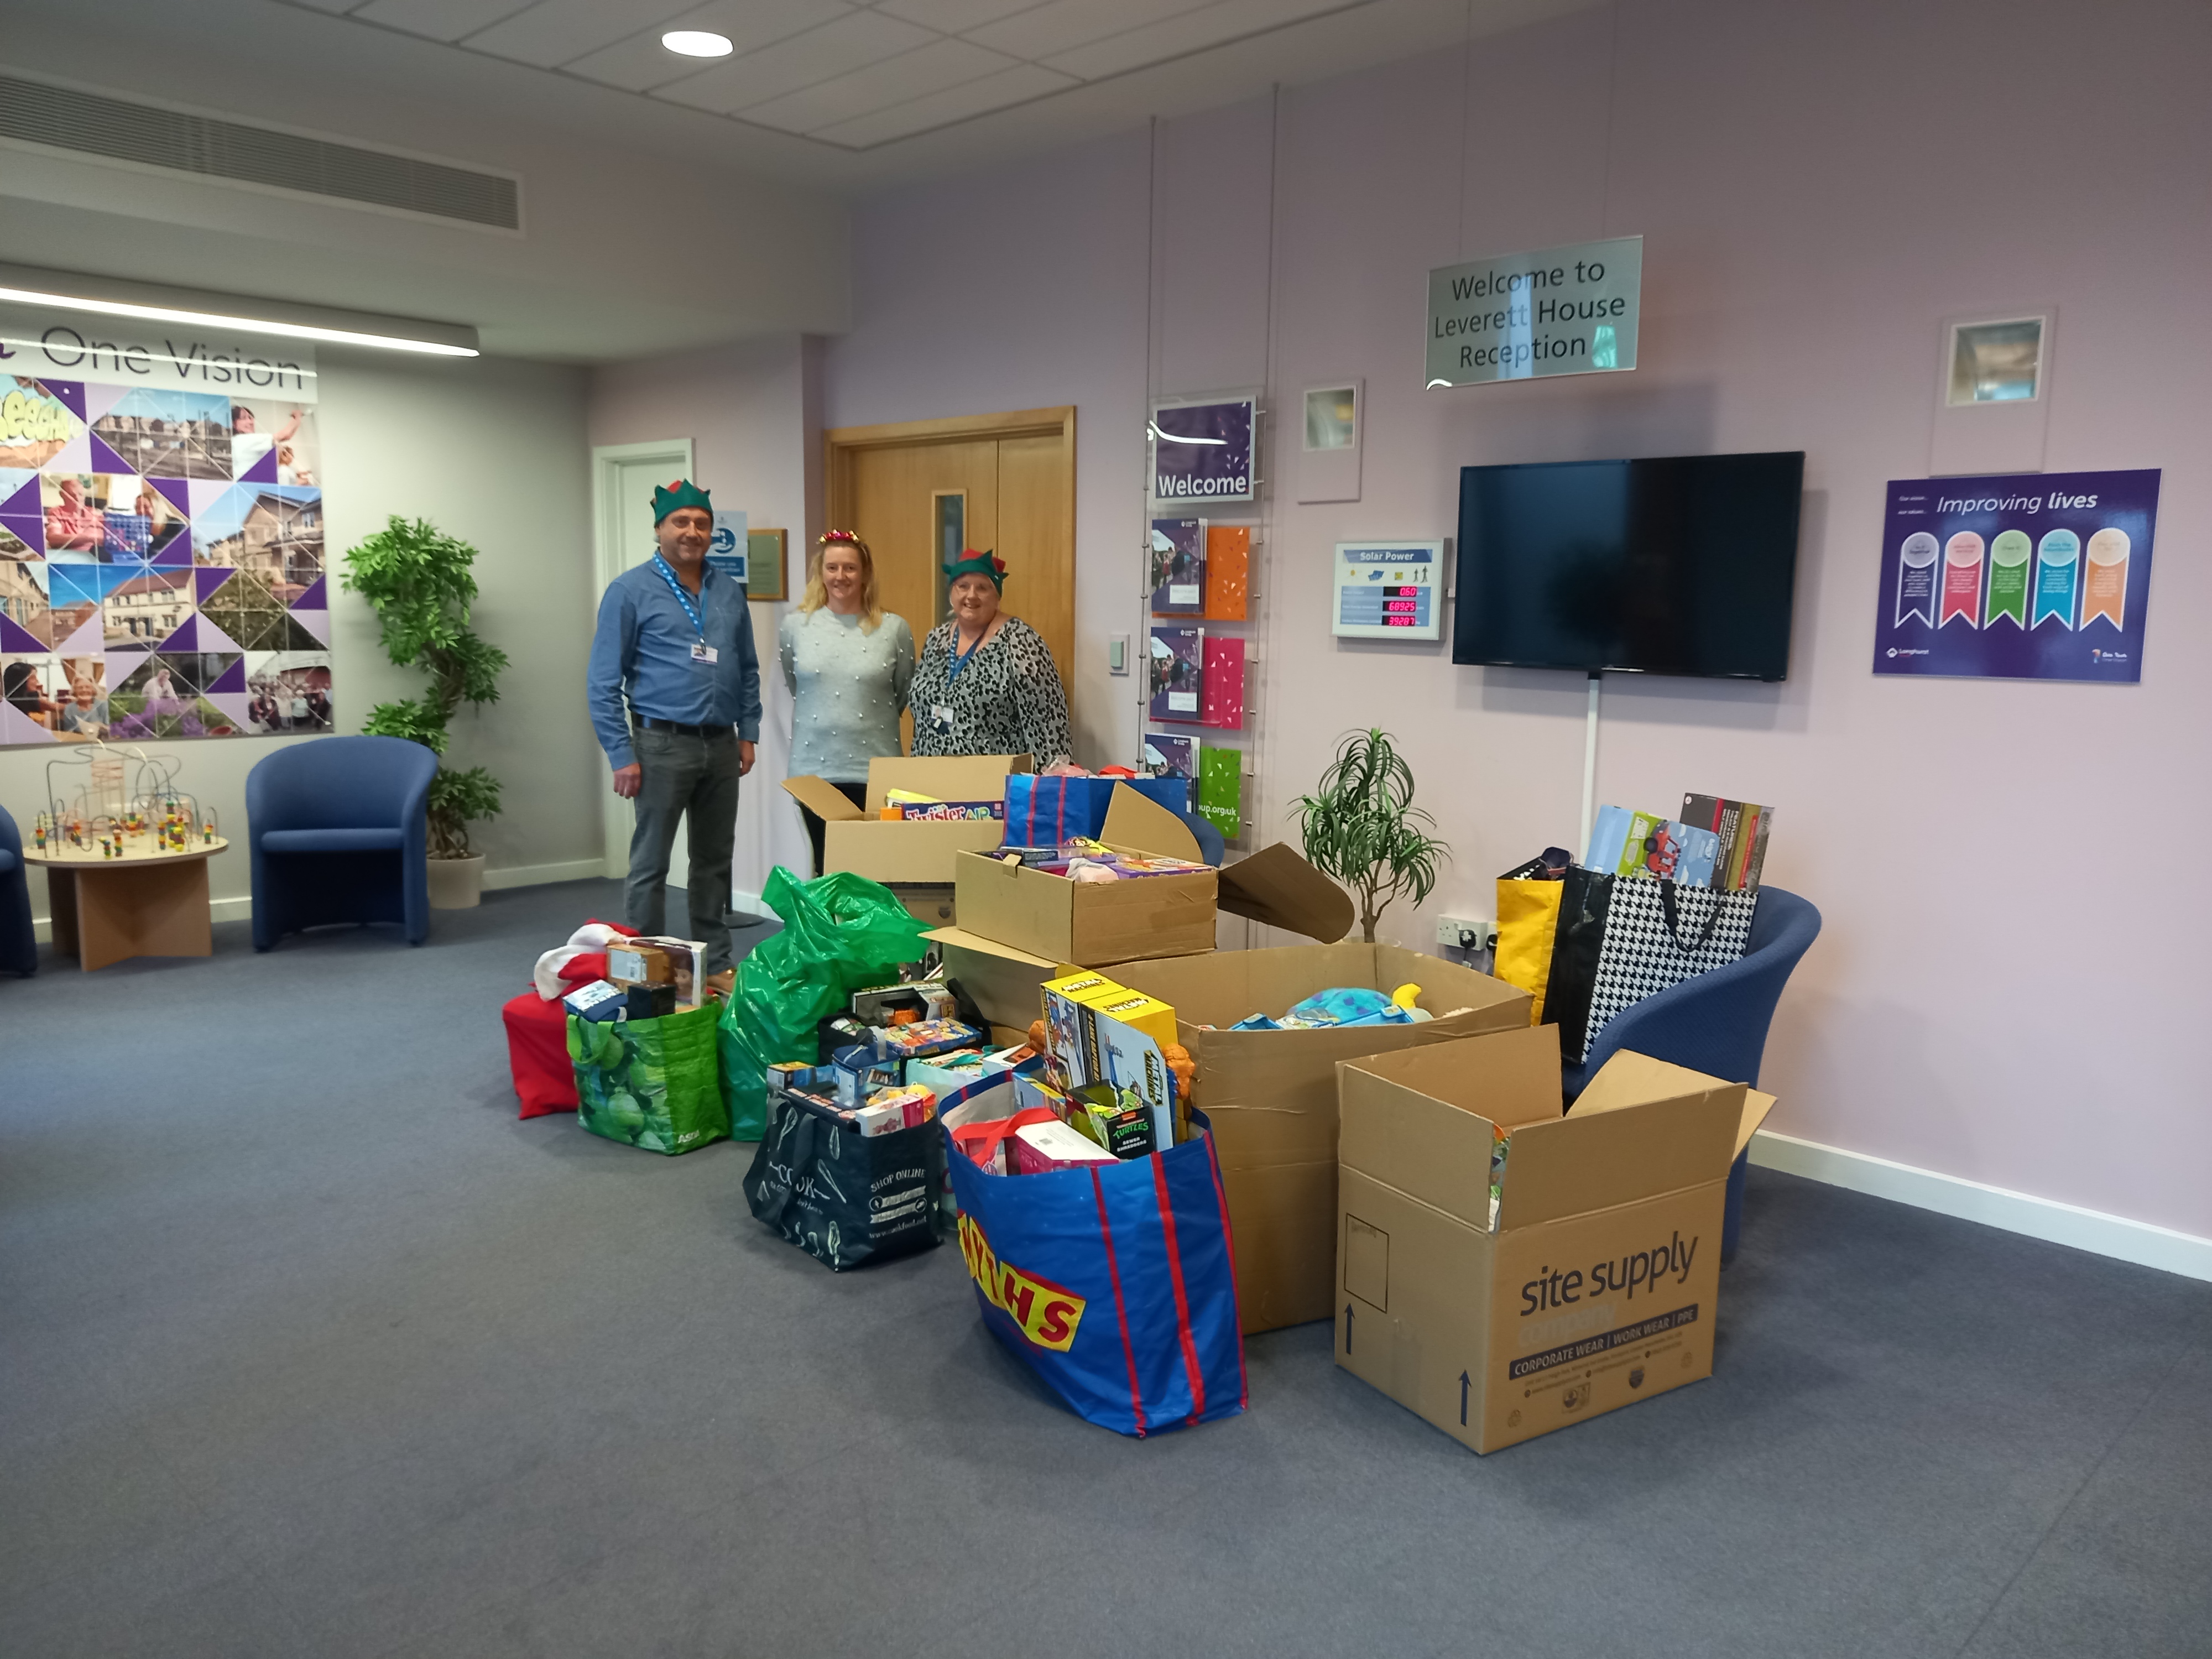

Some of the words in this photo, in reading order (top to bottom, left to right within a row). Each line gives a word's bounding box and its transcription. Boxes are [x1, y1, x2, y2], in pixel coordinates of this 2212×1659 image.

[1452, 268, 1564, 301] Welcome
[1575, 260, 1605, 283] to
[1435, 303, 1528, 338] Leverett
[1538, 297, 1626, 324] House
[41, 326, 150, 375] One
[165, 340, 303, 389] Vision
[1460, 335, 1586, 368] Reception
[1159, 474, 1247, 497] Welcome
[1937, 494, 2042, 516] Improving
[2048, 492, 2098, 510] lives
[1360, 552, 1383, 561] Solar
[1385, 552, 1414, 561] Power
[1389, 602, 1415, 611] 68925
[1389, 617, 1415, 625] 39287
[1145, 1053, 1155, 1099] MACHINES
[1151, 1057, 1162, 1103] METAL
[1113, 1122, 1149, 1139] TURTLES
[870, 1174, 894, 1192] SHOP
[896, 1168, 926, 1180] ONLINE
[1520, 1266, 1583, 1316] site
[1590, 1231, 1699, 1299] supply
[1514, 1348, 1574, 1376] CORPORATE
[1576, 1338, 1604, 1357] WEAR
[1613, 1326, 1641, 1345] WORK
[1643, 1317, 1670, 1335] WEAR
[1677, 1308, 1695, 1325] PPE
